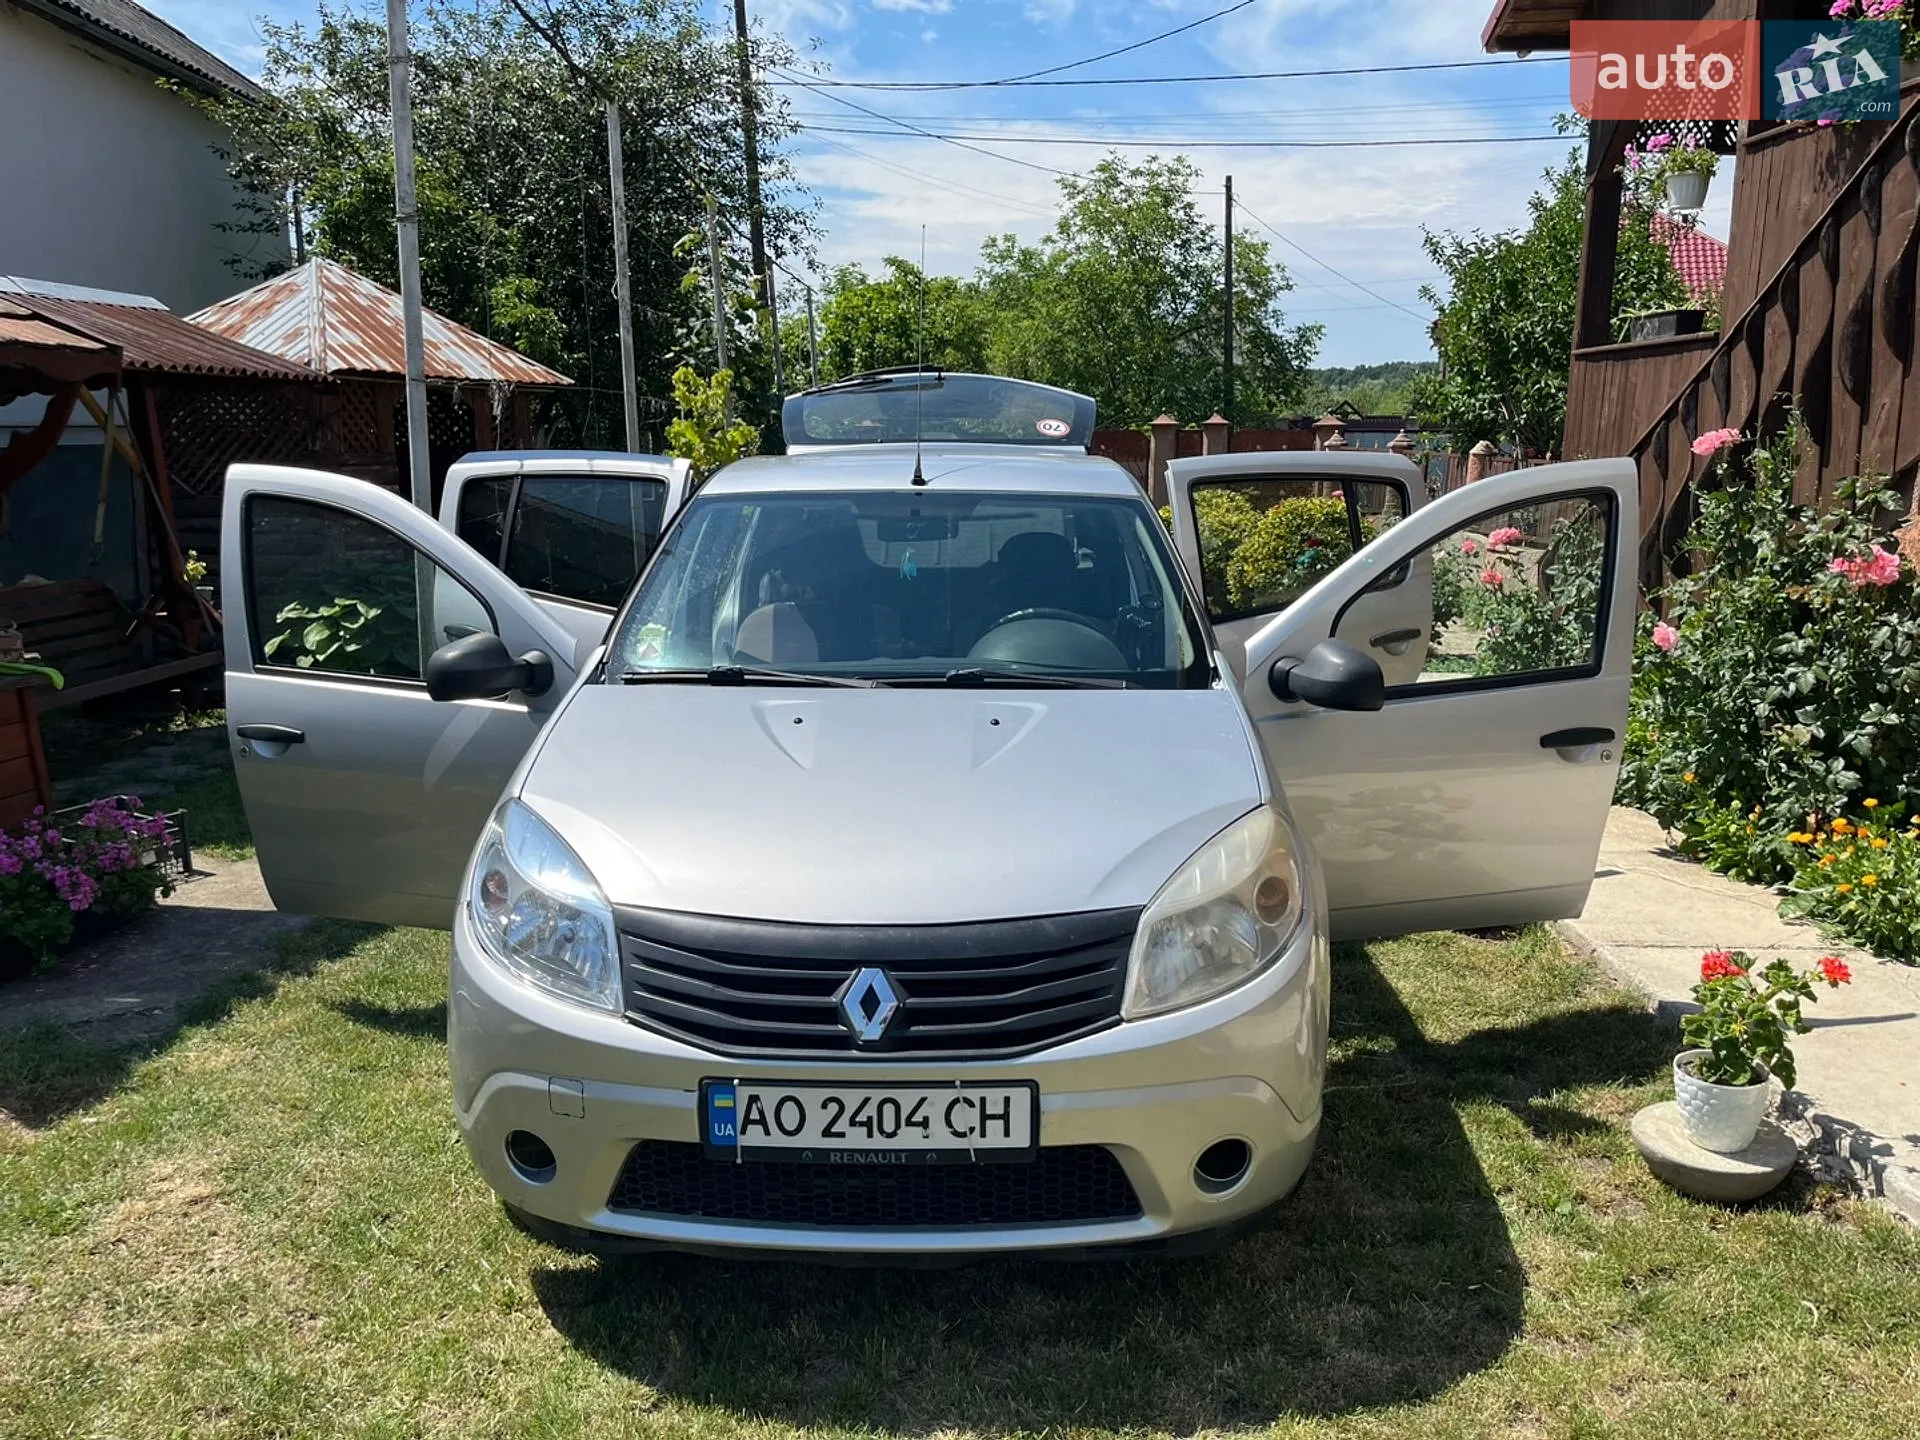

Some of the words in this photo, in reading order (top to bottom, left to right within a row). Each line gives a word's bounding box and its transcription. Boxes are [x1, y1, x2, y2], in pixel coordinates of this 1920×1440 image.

[1043, 423, 1062, 431] 70
[739, 1094, 807, 1137] AO
[820, 1096, 930, 1139] 2404
[944, 1096, 1011, 1139] CH
[714, 1124, 736, 1137] UA
[830, 1151, 909, 1164] RENAULT
